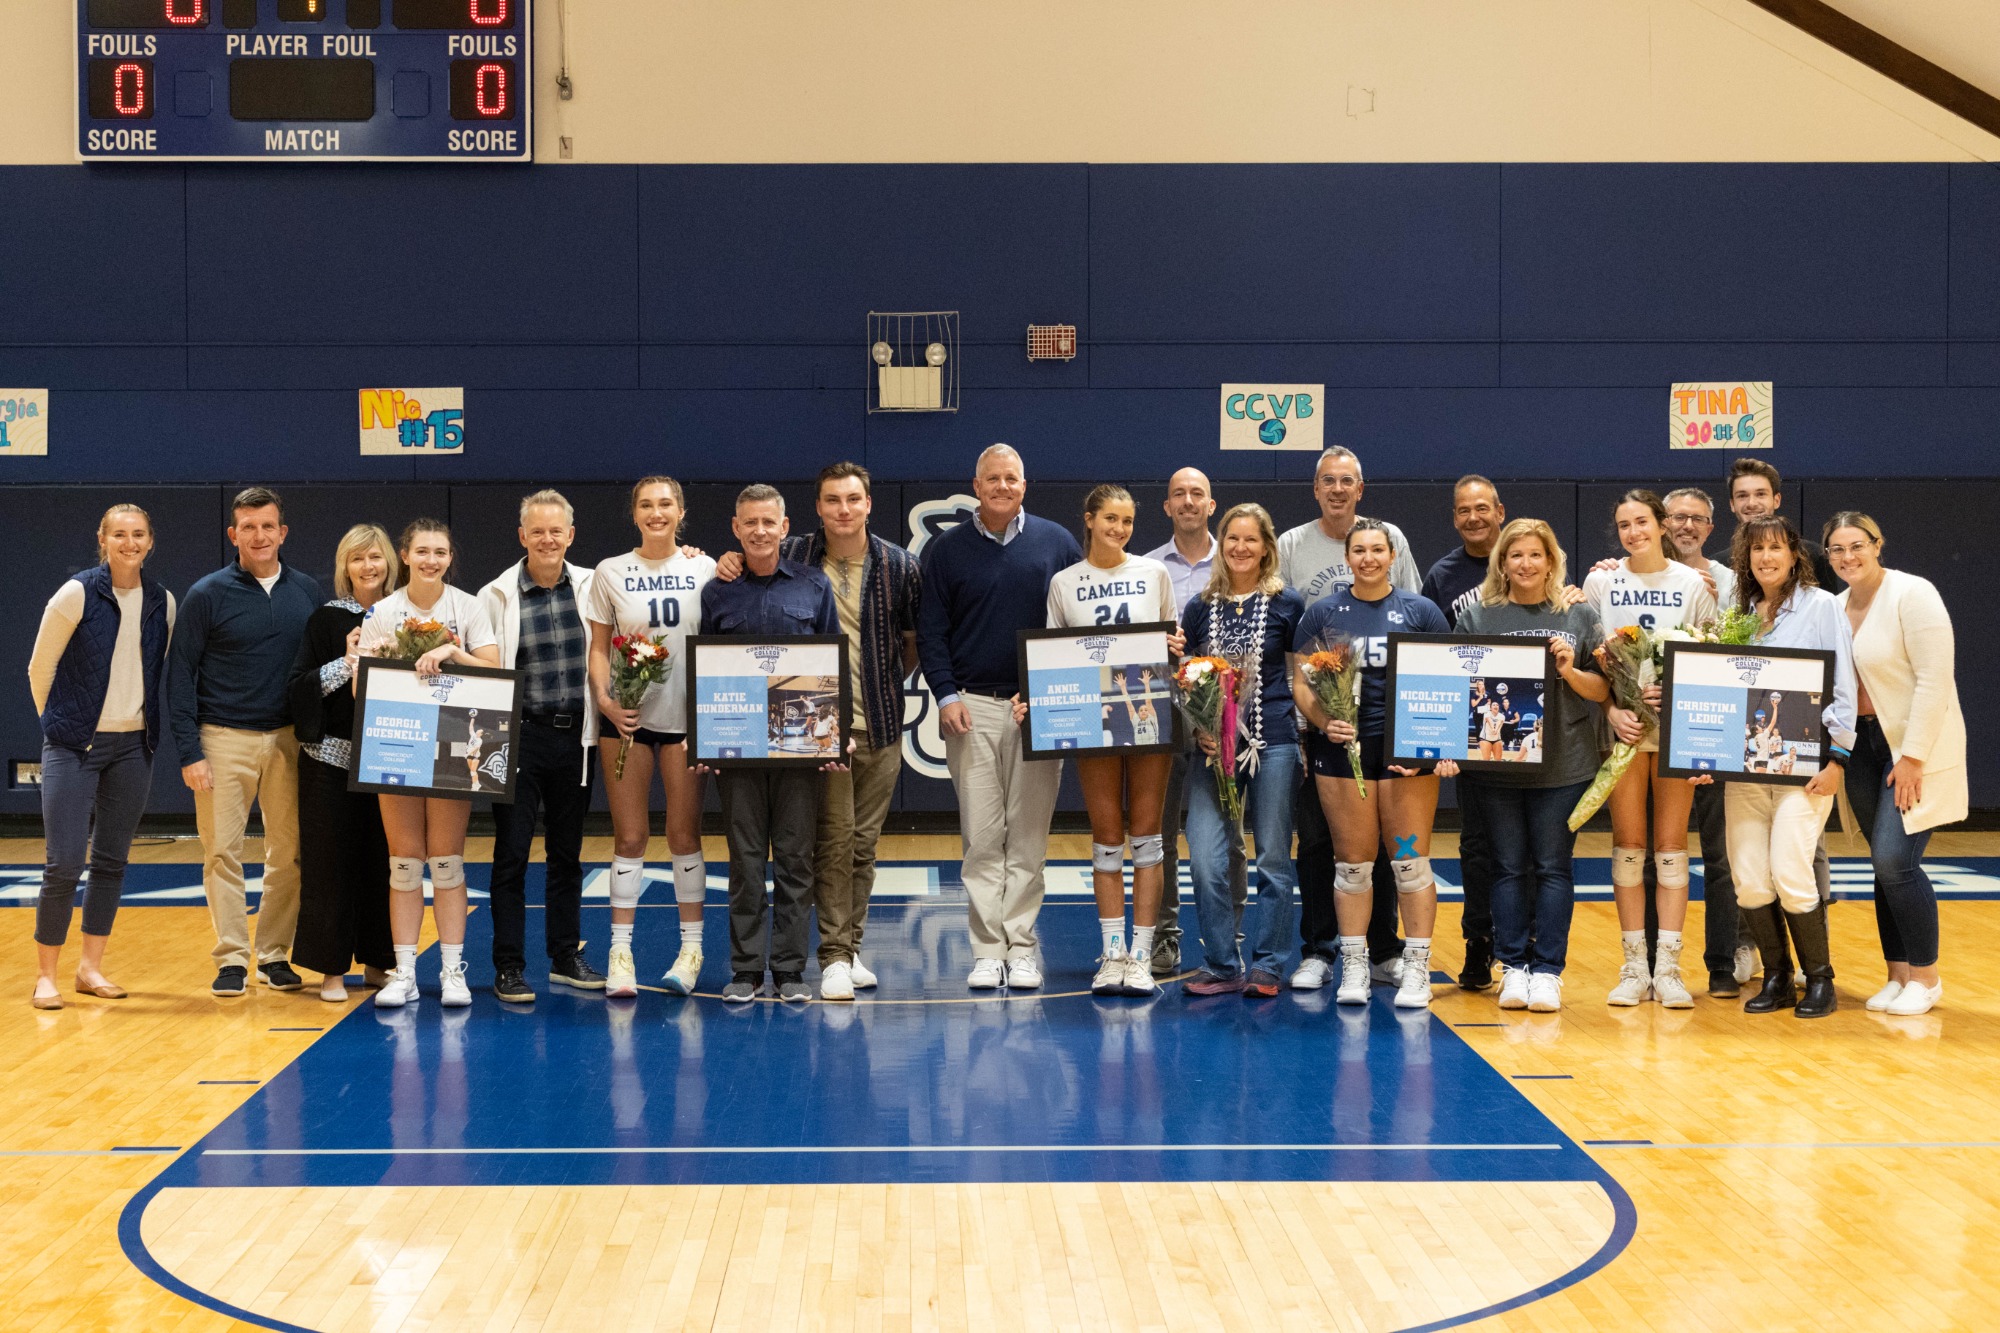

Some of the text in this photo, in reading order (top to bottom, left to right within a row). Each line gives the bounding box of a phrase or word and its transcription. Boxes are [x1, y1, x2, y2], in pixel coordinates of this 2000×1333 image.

[88, 35, 157, 56] FOULS
[226, 35, 377, 56] PLAYER FOUL
[448, 35, 517, 57] FOULS
[115, 64, 143, 115] 0
[476, 64, 506, 115] 0
[88, 129, 157, 151] SCORE
[265, 129, 340, 151] MATCH
[448, 129, 517, 151] SCORE
[360, 389, 422, 430] Nic
[1226, 393, 1314, 421] CCVB
[1674, 386, 1749, 415] TINA
[398, 408, 465, 450] #15
[625, 575, 696, 592] CAMELS
[1077, 580, 1147, 602] CAMELS
[1610, 590, 1683, 607] CAMELS
[647, 597, 680, 628] 10
[1094, 602, 1131, 626] 24
[1224, 617, 1252, 628] ENIOR
[1353, 636, 1388, 668] 15
[1449, 645, 1493, 653] CONNECTICUT
[1726, 656, 1771, 665] CONNECTICUT
[713, 692, 746, 702] KATIE
[1047, 683, 1080, 694] ANNIE
[1400, 690, 1461, 702] NICOLETTE
[696, 703, 763, 714] GUNDERMAN
[1029, 693, 1100, 707] WIBBELSMAN
[1408, 702, 1452, 713] MARINO
[1677, 700, 1737, 713] CHRISTINA
[375, 716, 421, 729] GEORGIA
[1688, 712, 1724, 725] LEDUC
